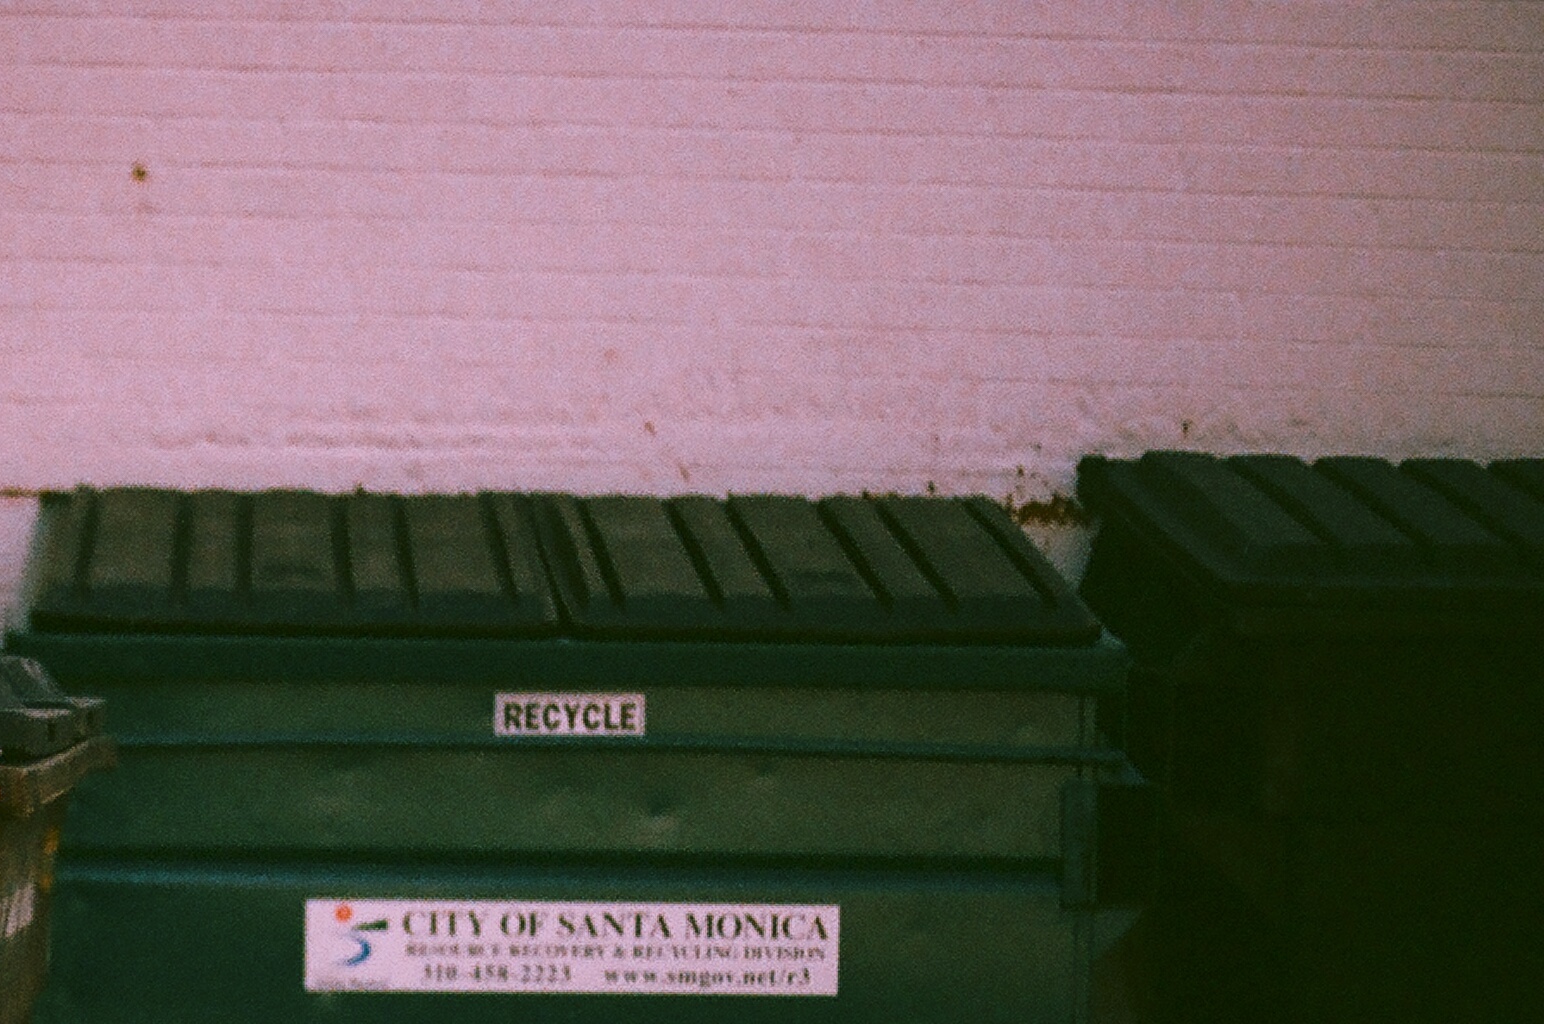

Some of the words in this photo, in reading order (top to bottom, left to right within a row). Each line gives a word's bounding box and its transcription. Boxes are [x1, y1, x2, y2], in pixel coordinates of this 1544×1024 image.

[503, 701, 636, 730] RECYCLE
[402, 910, 486, 937] CITY
[500, 910, 544, 937] OF
[556, 911, 671, 938] SANTA
[685, 912, 828, 939] MONICA
[509, 944, 605, 958] RECOVERY
[613, 945, 625, 958] &
[633, 945, 736, 959] RECYCLING
[743, 946, 826, 960] DIVISION
